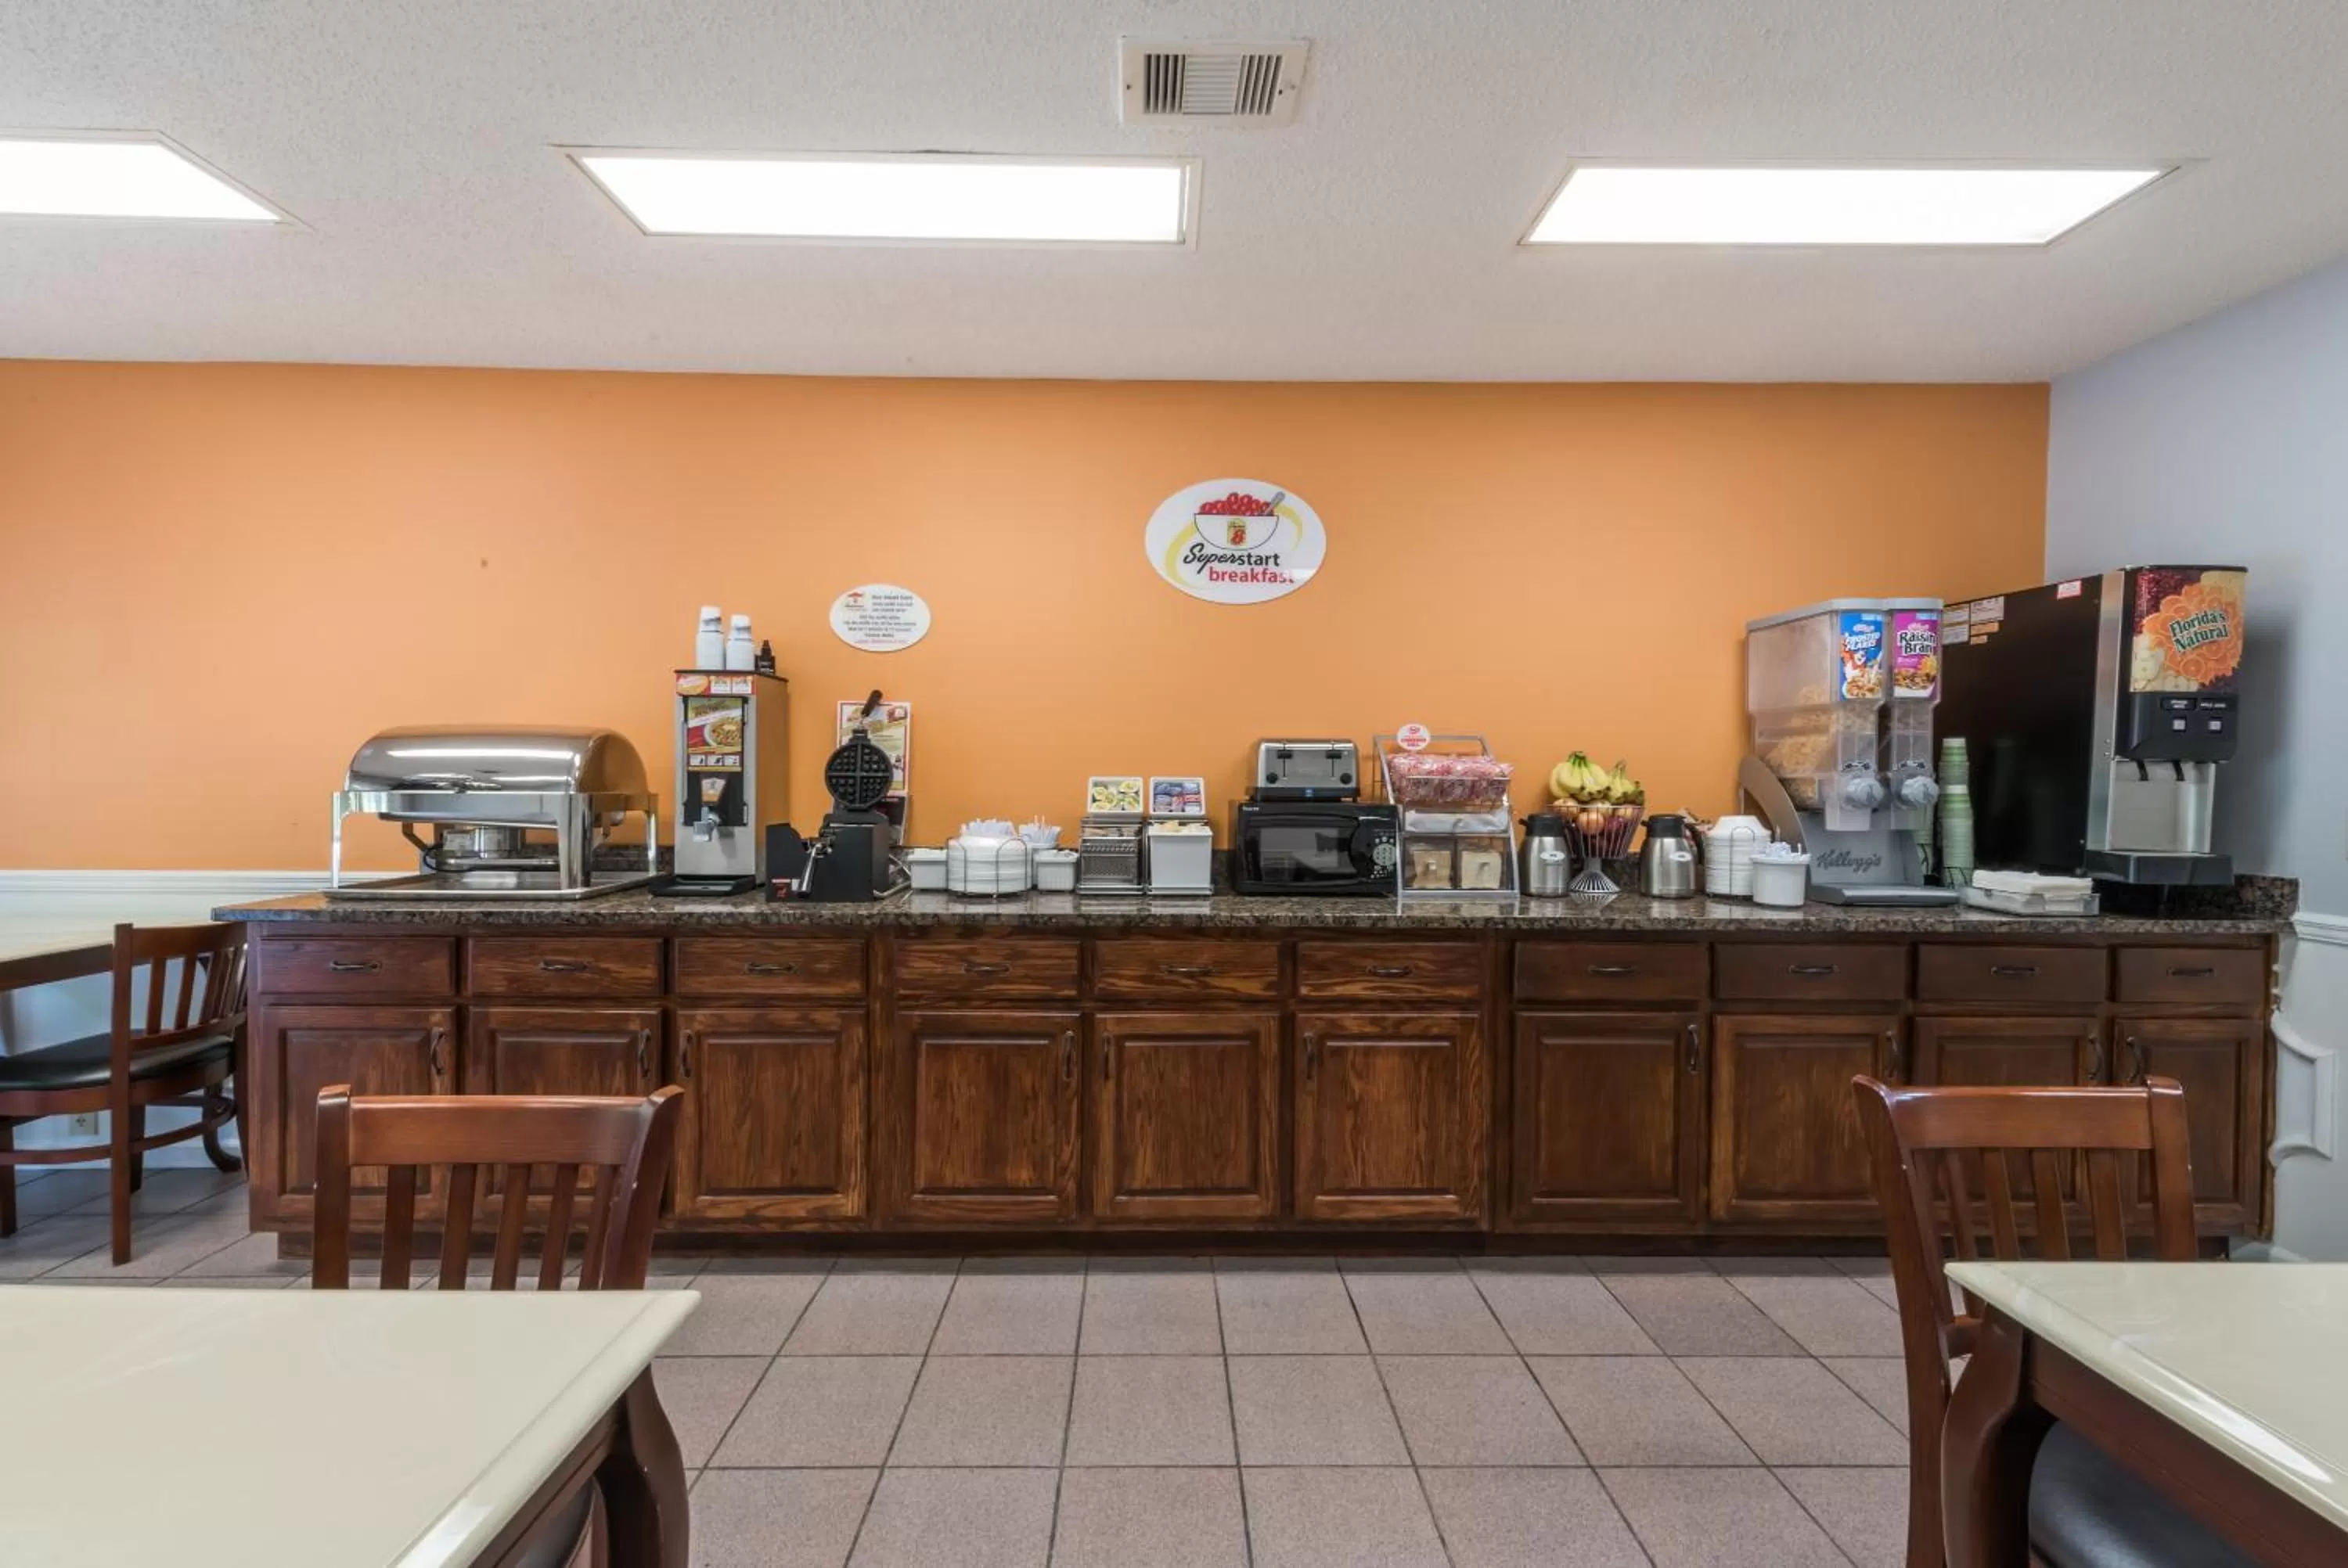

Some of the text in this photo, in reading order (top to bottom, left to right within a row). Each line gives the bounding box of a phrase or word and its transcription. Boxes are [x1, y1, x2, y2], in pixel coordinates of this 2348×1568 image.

[1183, 542, 1280, 575] Superstart
[1900, 631, 1936, 643] Raisin
[2169, 610, 2227, 637] Florida's
[1904, 642, 1932, 654] Bran
[2173, 624, 2229, 653] Natural
[1816, 847, 1882, 874] Kellogg's
